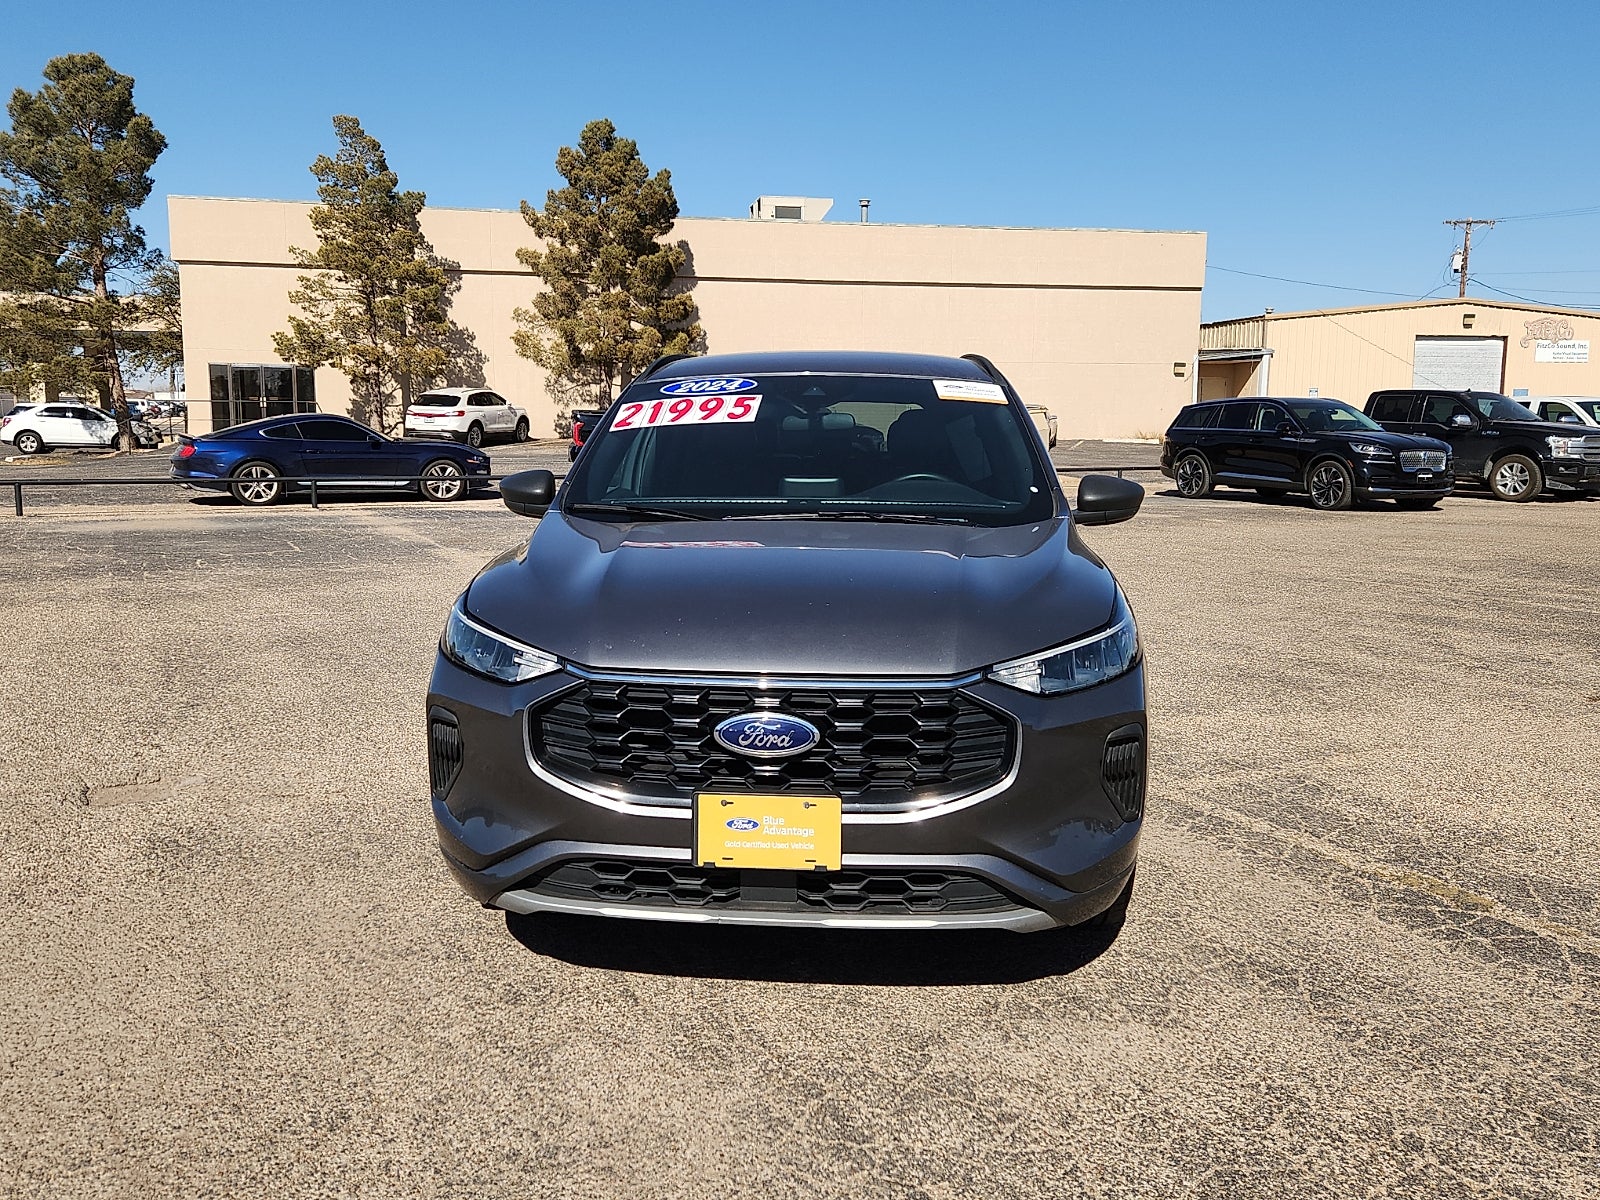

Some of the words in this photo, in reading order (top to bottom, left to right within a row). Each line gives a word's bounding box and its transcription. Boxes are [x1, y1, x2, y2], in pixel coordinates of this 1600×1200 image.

[674, 378, 741, 393] 2024
[614, 396, 757, 428] 21995
[738, 722, 795, 748] Ford
[731, 818, 755, 830] Ford
[763, 815, 785, 825] Blue
[762, 826, 815, 837] Advantage
[724, 840, 741, 848] Gold
[742, 841, 771, 849] Certified
[772, 841, 789, 849] Used
[791, 842, 815, 850] Vehicle
